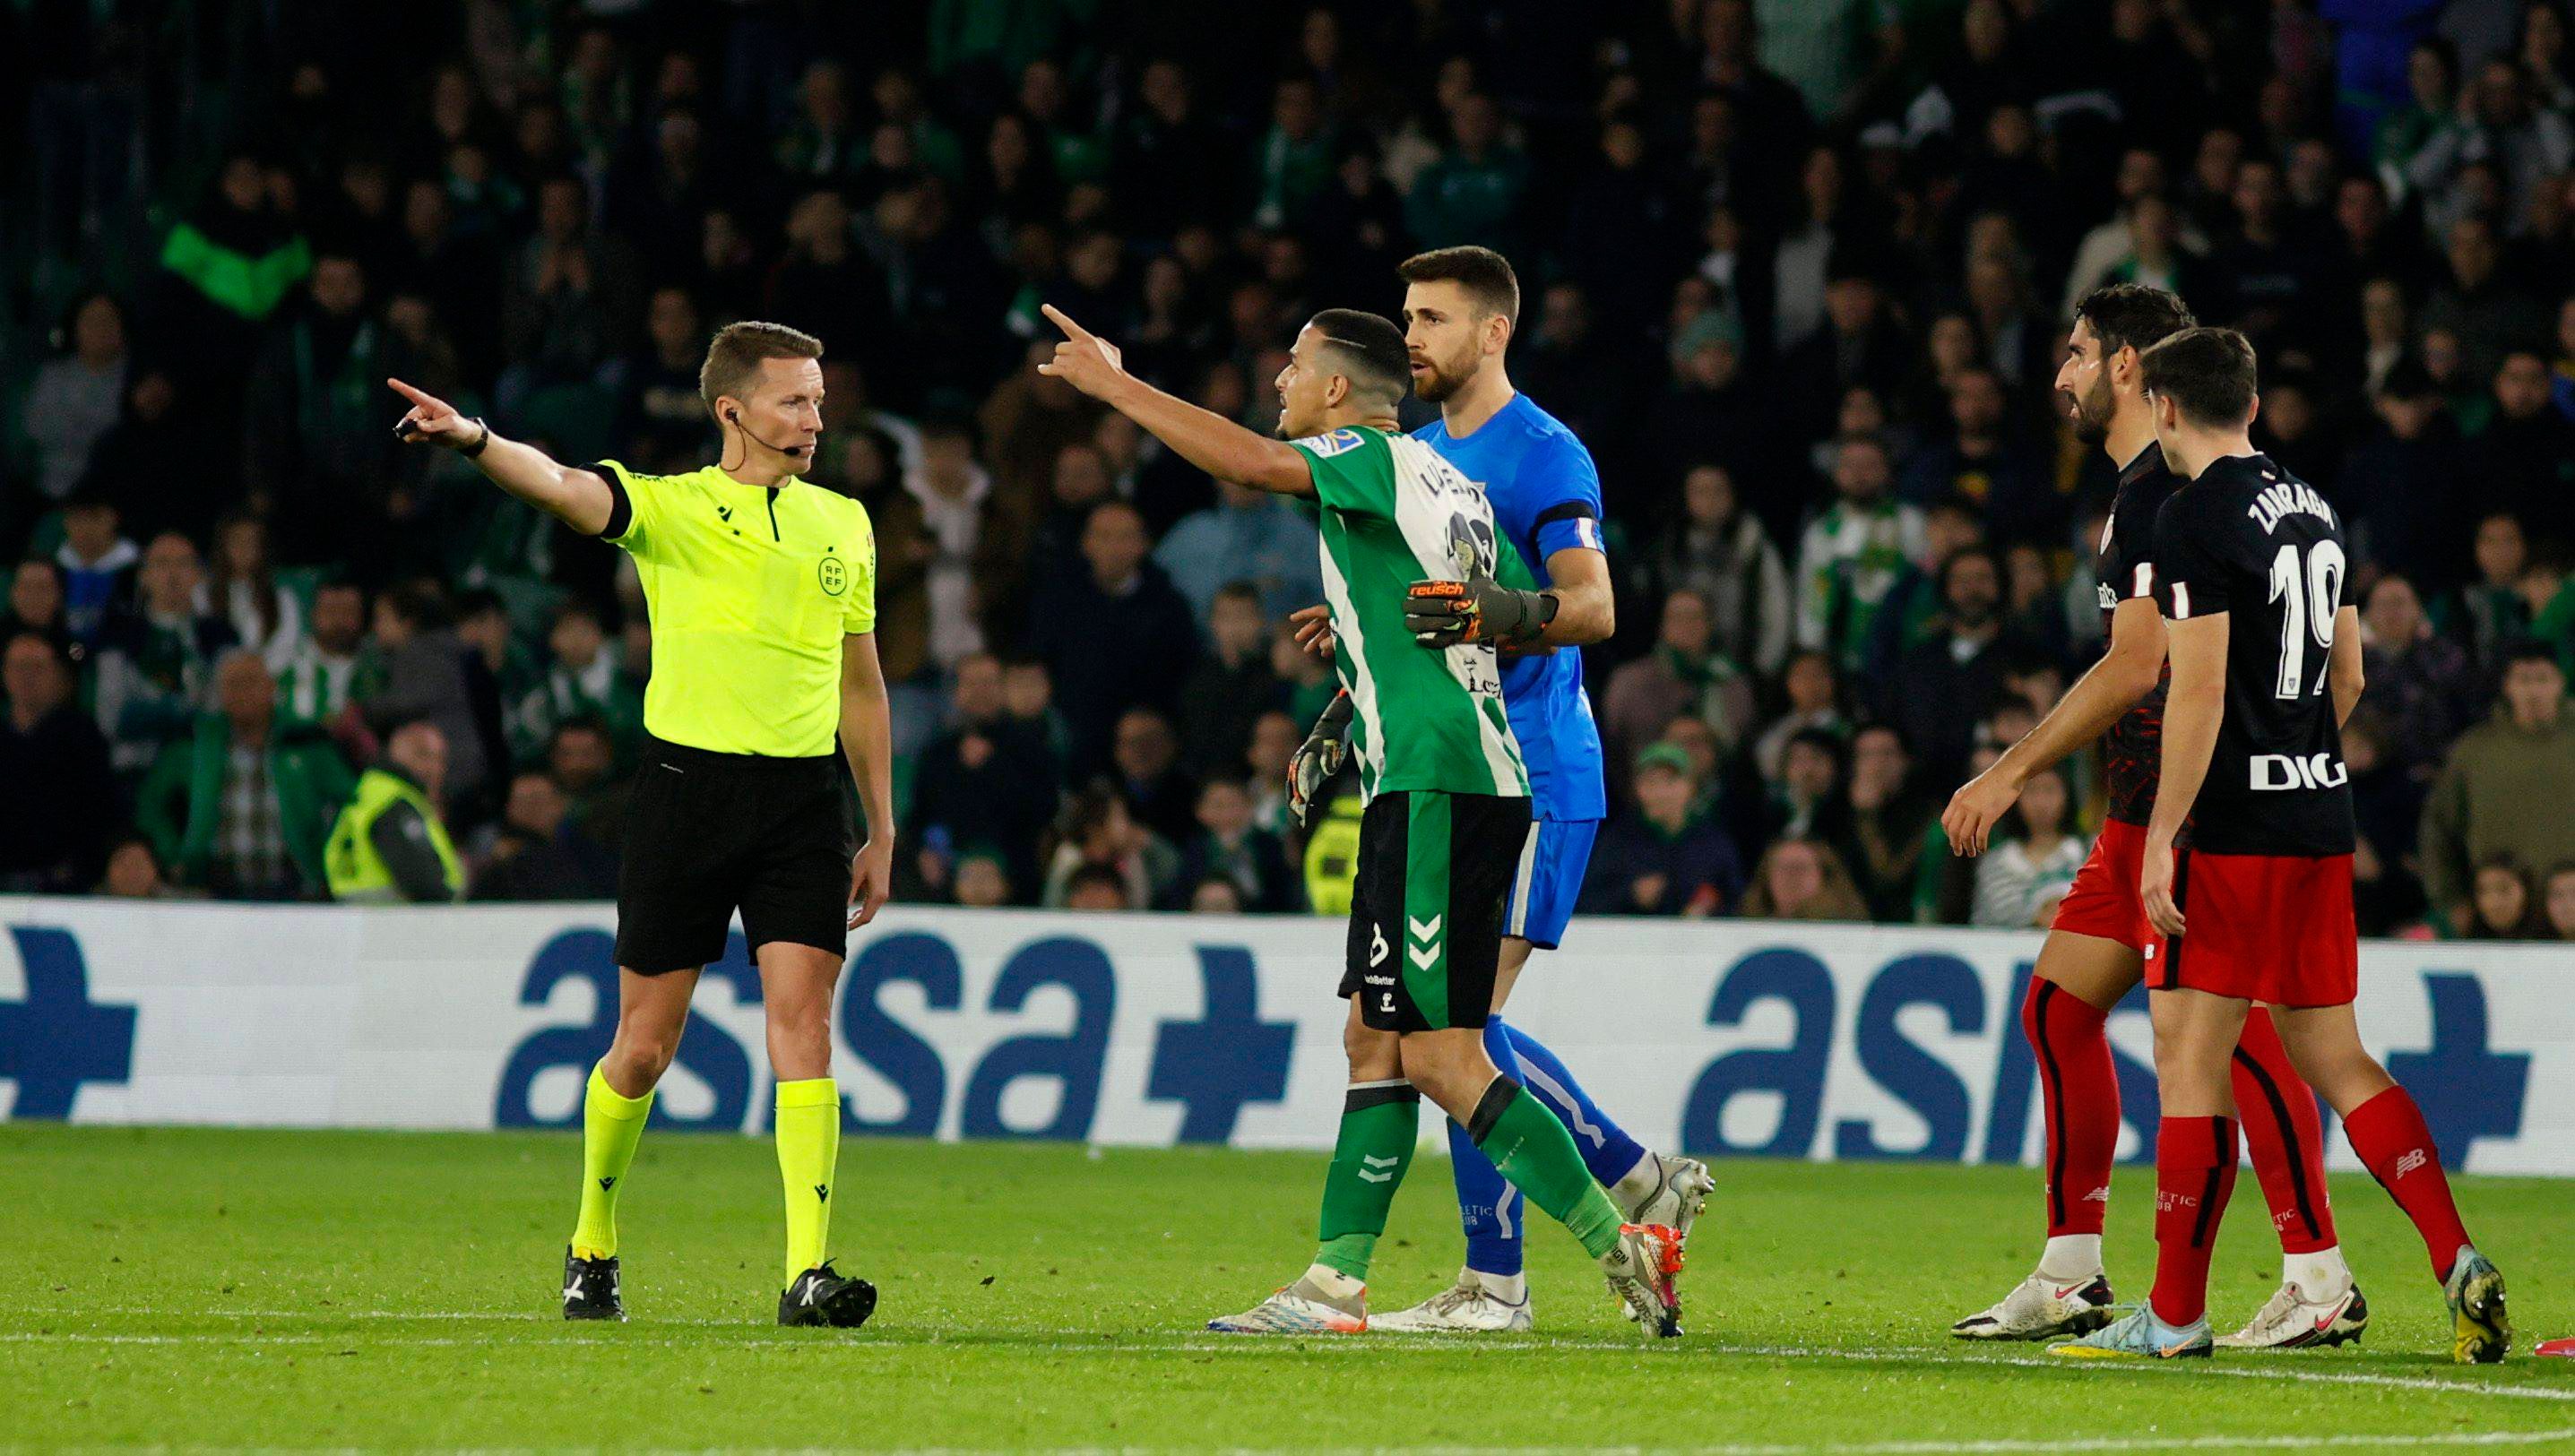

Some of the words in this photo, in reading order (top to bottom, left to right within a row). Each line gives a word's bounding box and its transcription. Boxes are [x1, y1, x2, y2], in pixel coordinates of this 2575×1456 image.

[1410, 582, 1465, 596] reusch
[2268, 538, 2346, 700] 19
[2250, 752, 2348, 791] DIG
